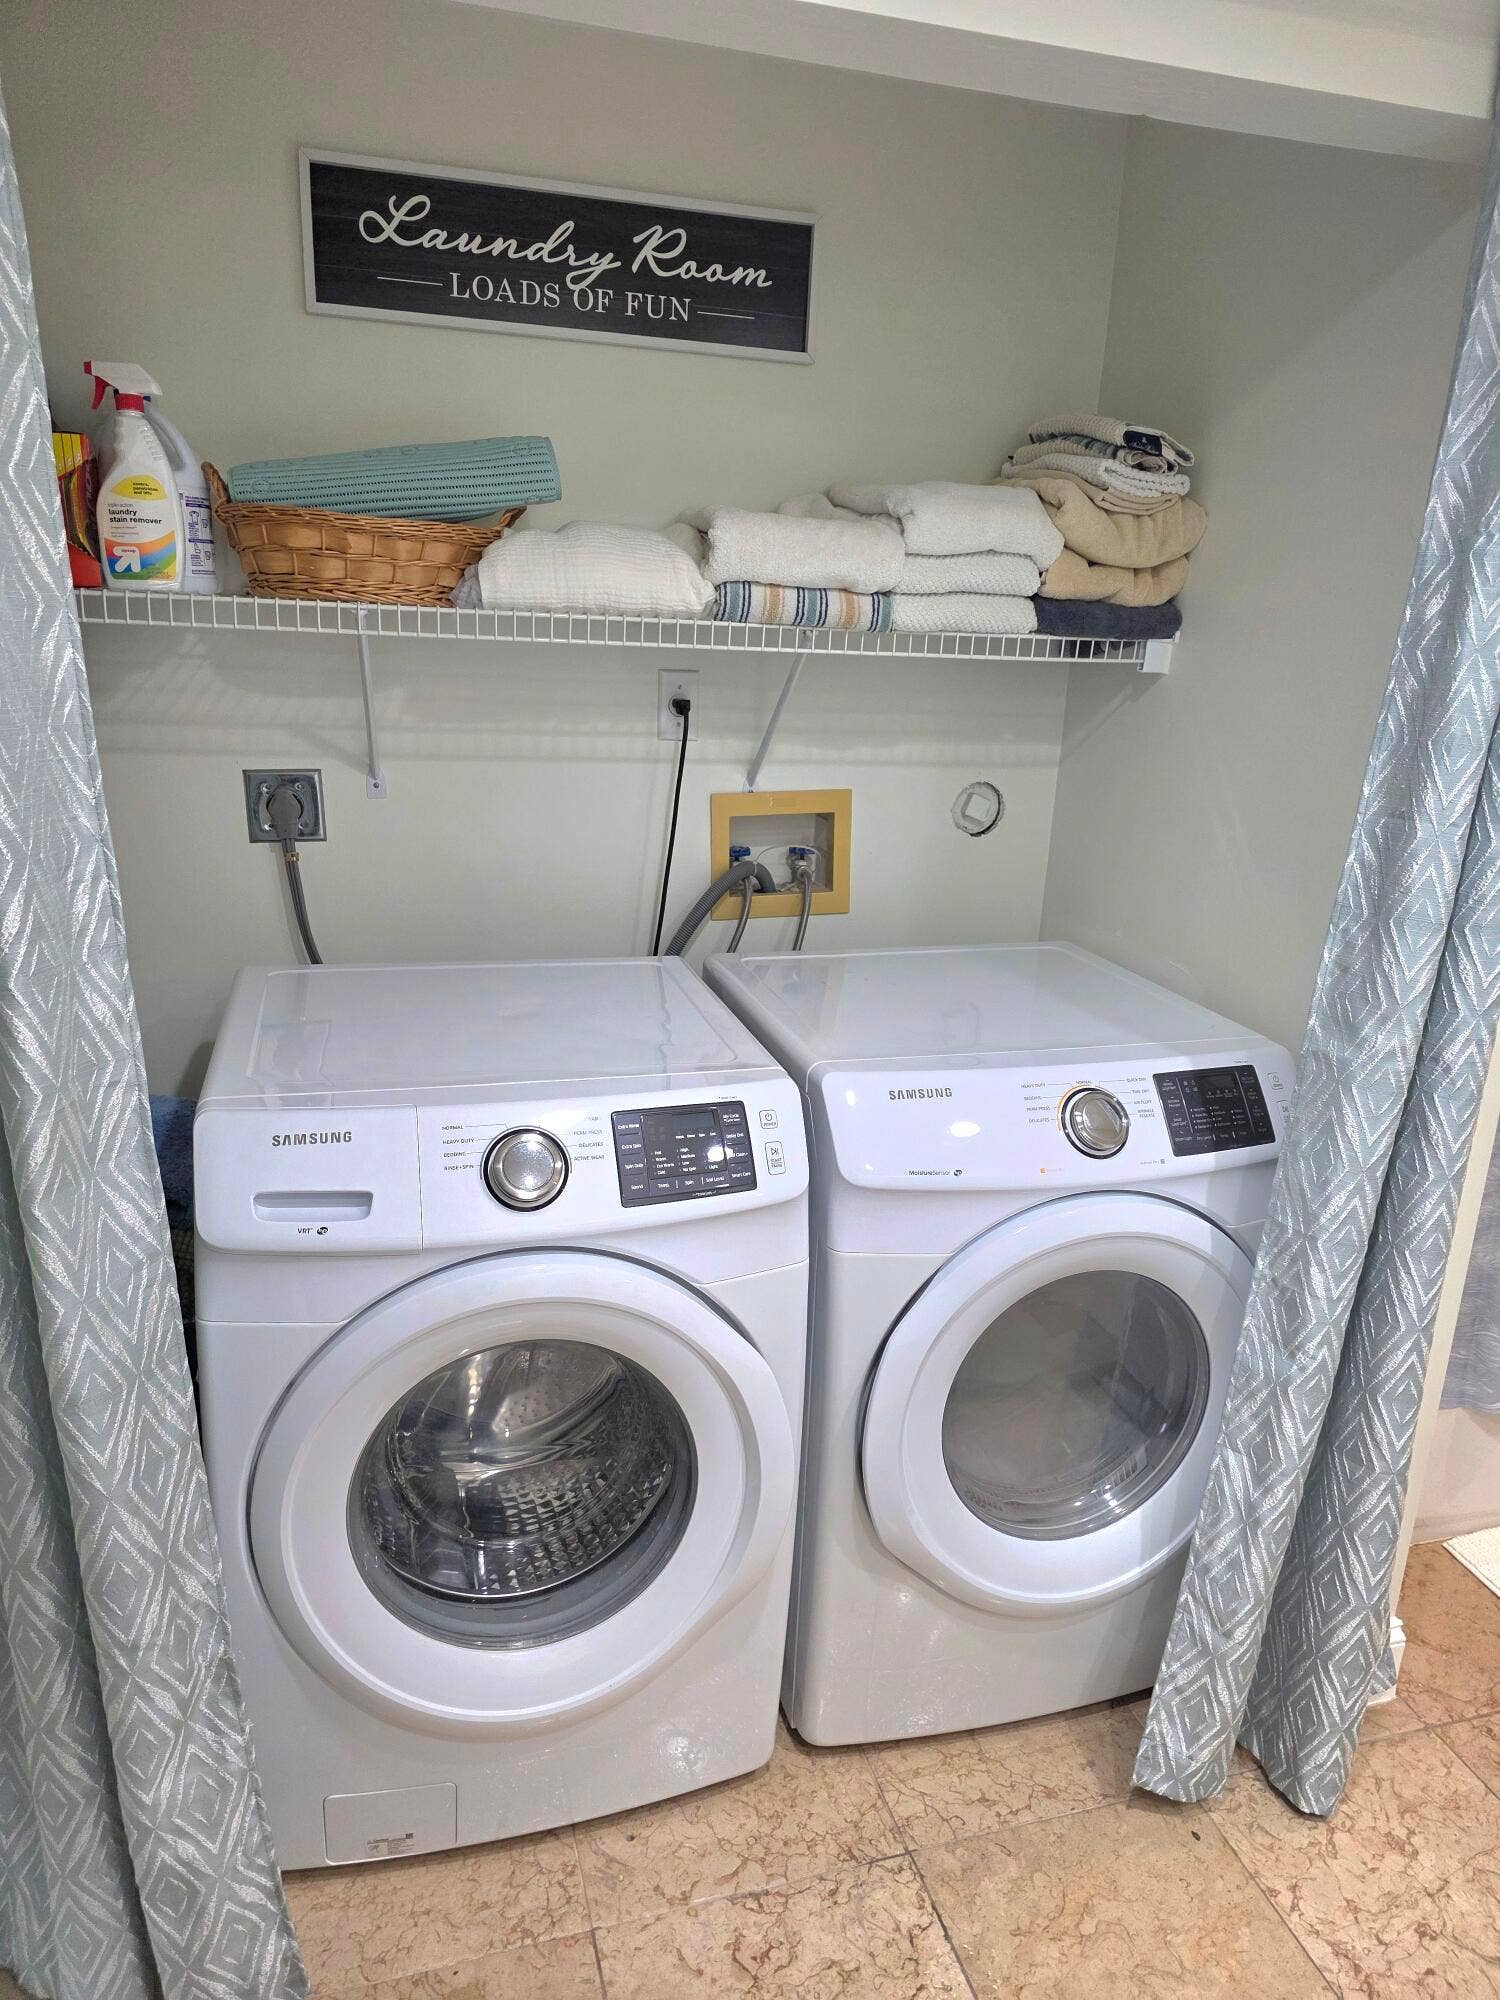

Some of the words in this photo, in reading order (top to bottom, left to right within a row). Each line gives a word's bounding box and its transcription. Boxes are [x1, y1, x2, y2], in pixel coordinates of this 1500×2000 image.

[359, 194, 621, 288] Laundry
[632, 225, 773, 288] Room
[449, 272, 560, 309] LOADS
[572, 286, 615, 314] OF
[624, 291, 692, 322] FUN
[108, 508, 137, 517] laundry
[129, 516, 162, 525] remover
[888, 1087, 953, 1100] SAMSUNG
[271, 1131, 353, 1147] SAMSUNG
